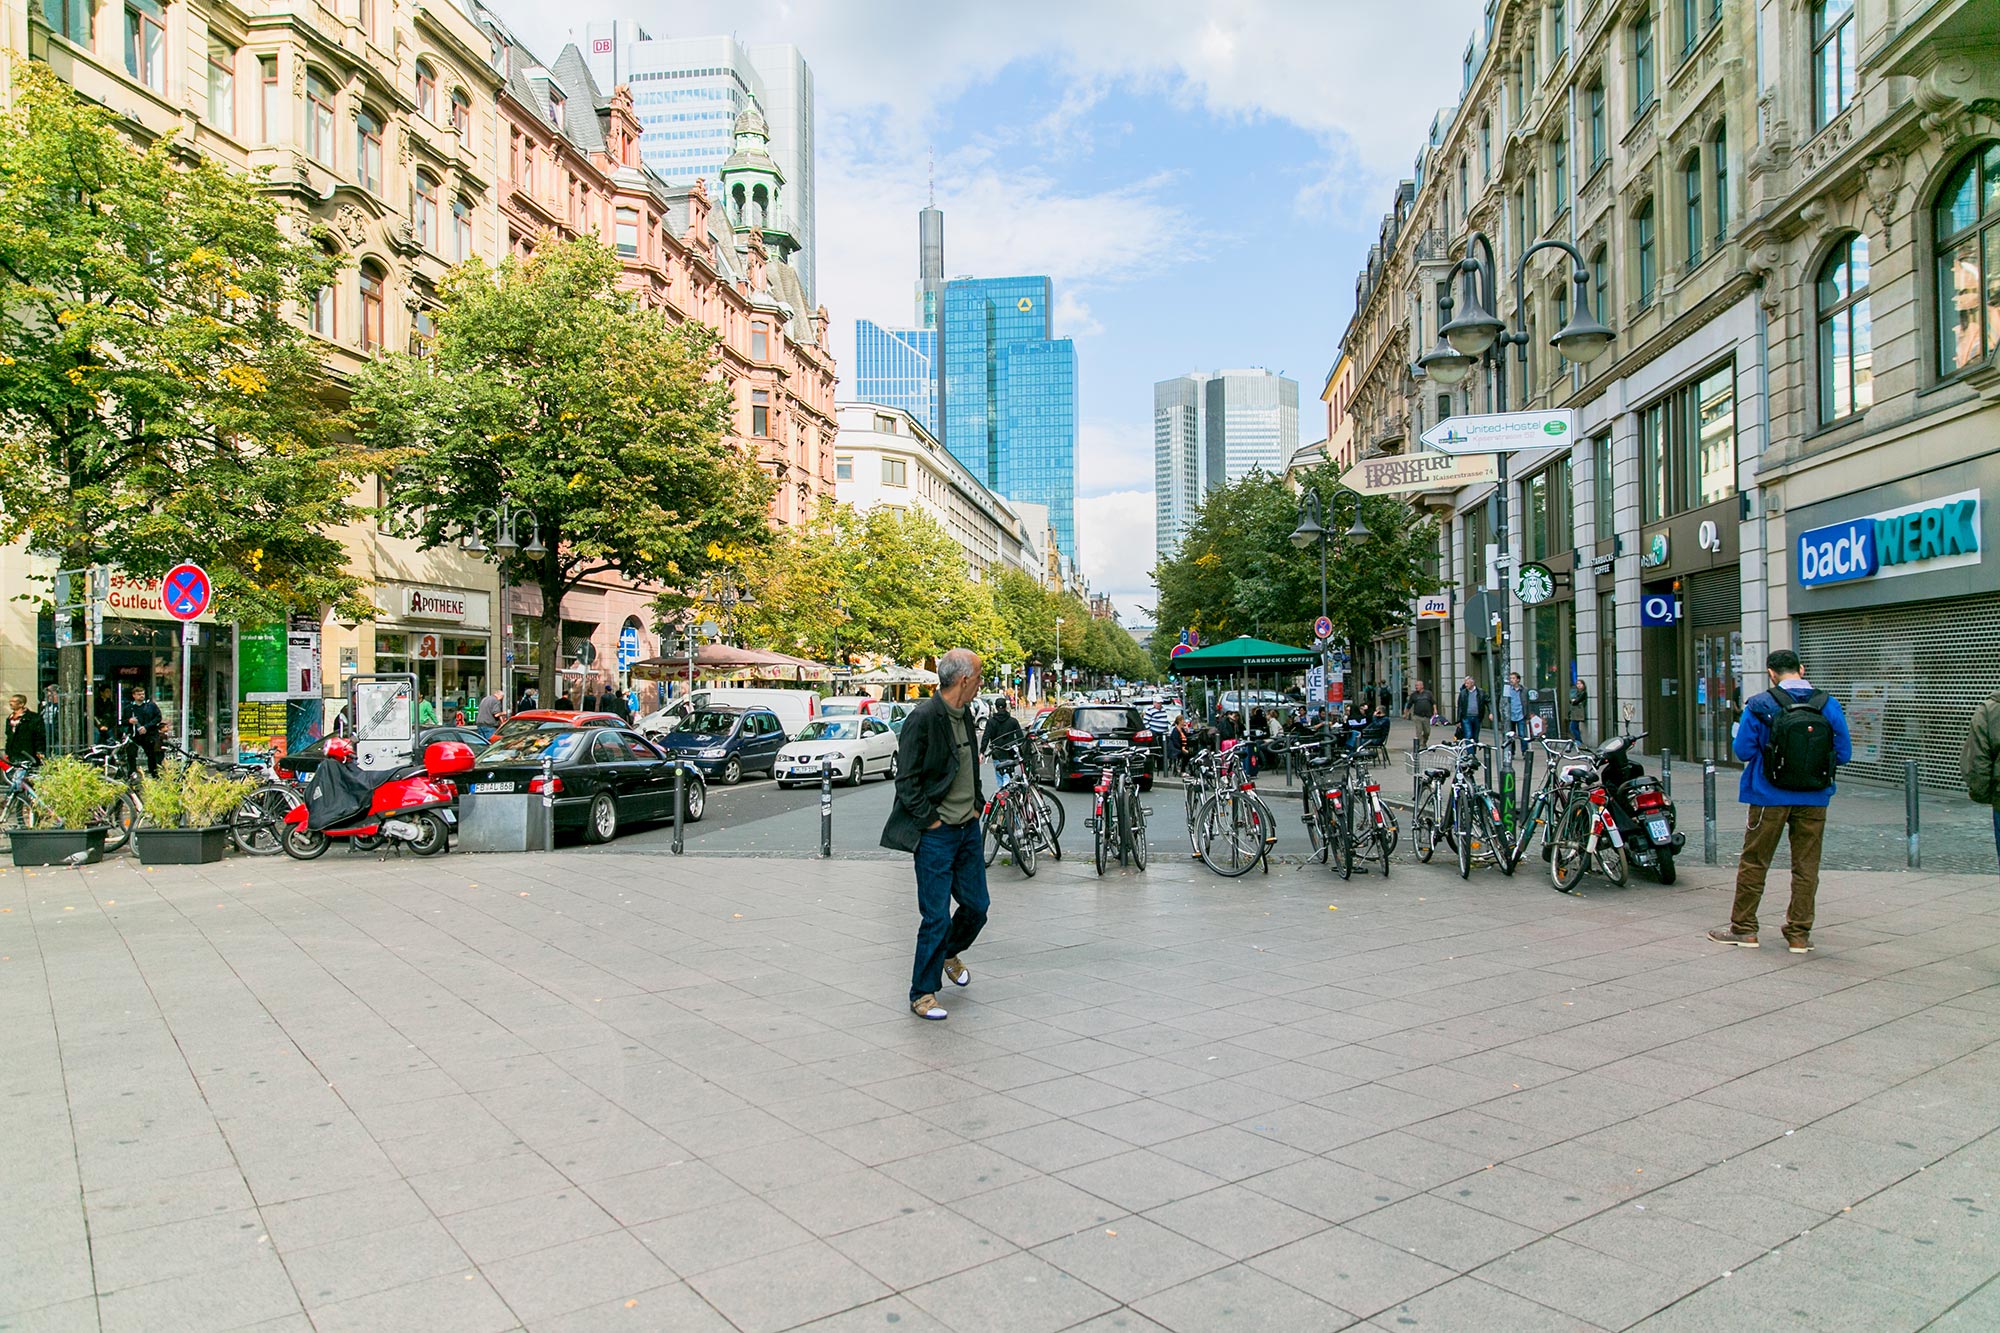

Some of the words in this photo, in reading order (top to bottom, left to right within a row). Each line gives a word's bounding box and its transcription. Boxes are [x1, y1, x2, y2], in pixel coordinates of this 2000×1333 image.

[595, 41, 610, 51] DB
[1466, 420, 1542, 435] United-Hostel
[1364, 455, 1453, 477] FRANKFURT
[1365, 470, 1430, 489] HOSTEL
[1433, 470, 1484, 481] Kaiserstrasse
[1485, 468, 1494, 476] 74
[1699, 520, 1720, 552] O2
[1590, 552, 1615, 567] STARBUCKS
[1594, 564, 1610, 575] COFFEE
[1425, 600, 1444, 611] dm
[1646, 598, 1673, 622] O2
